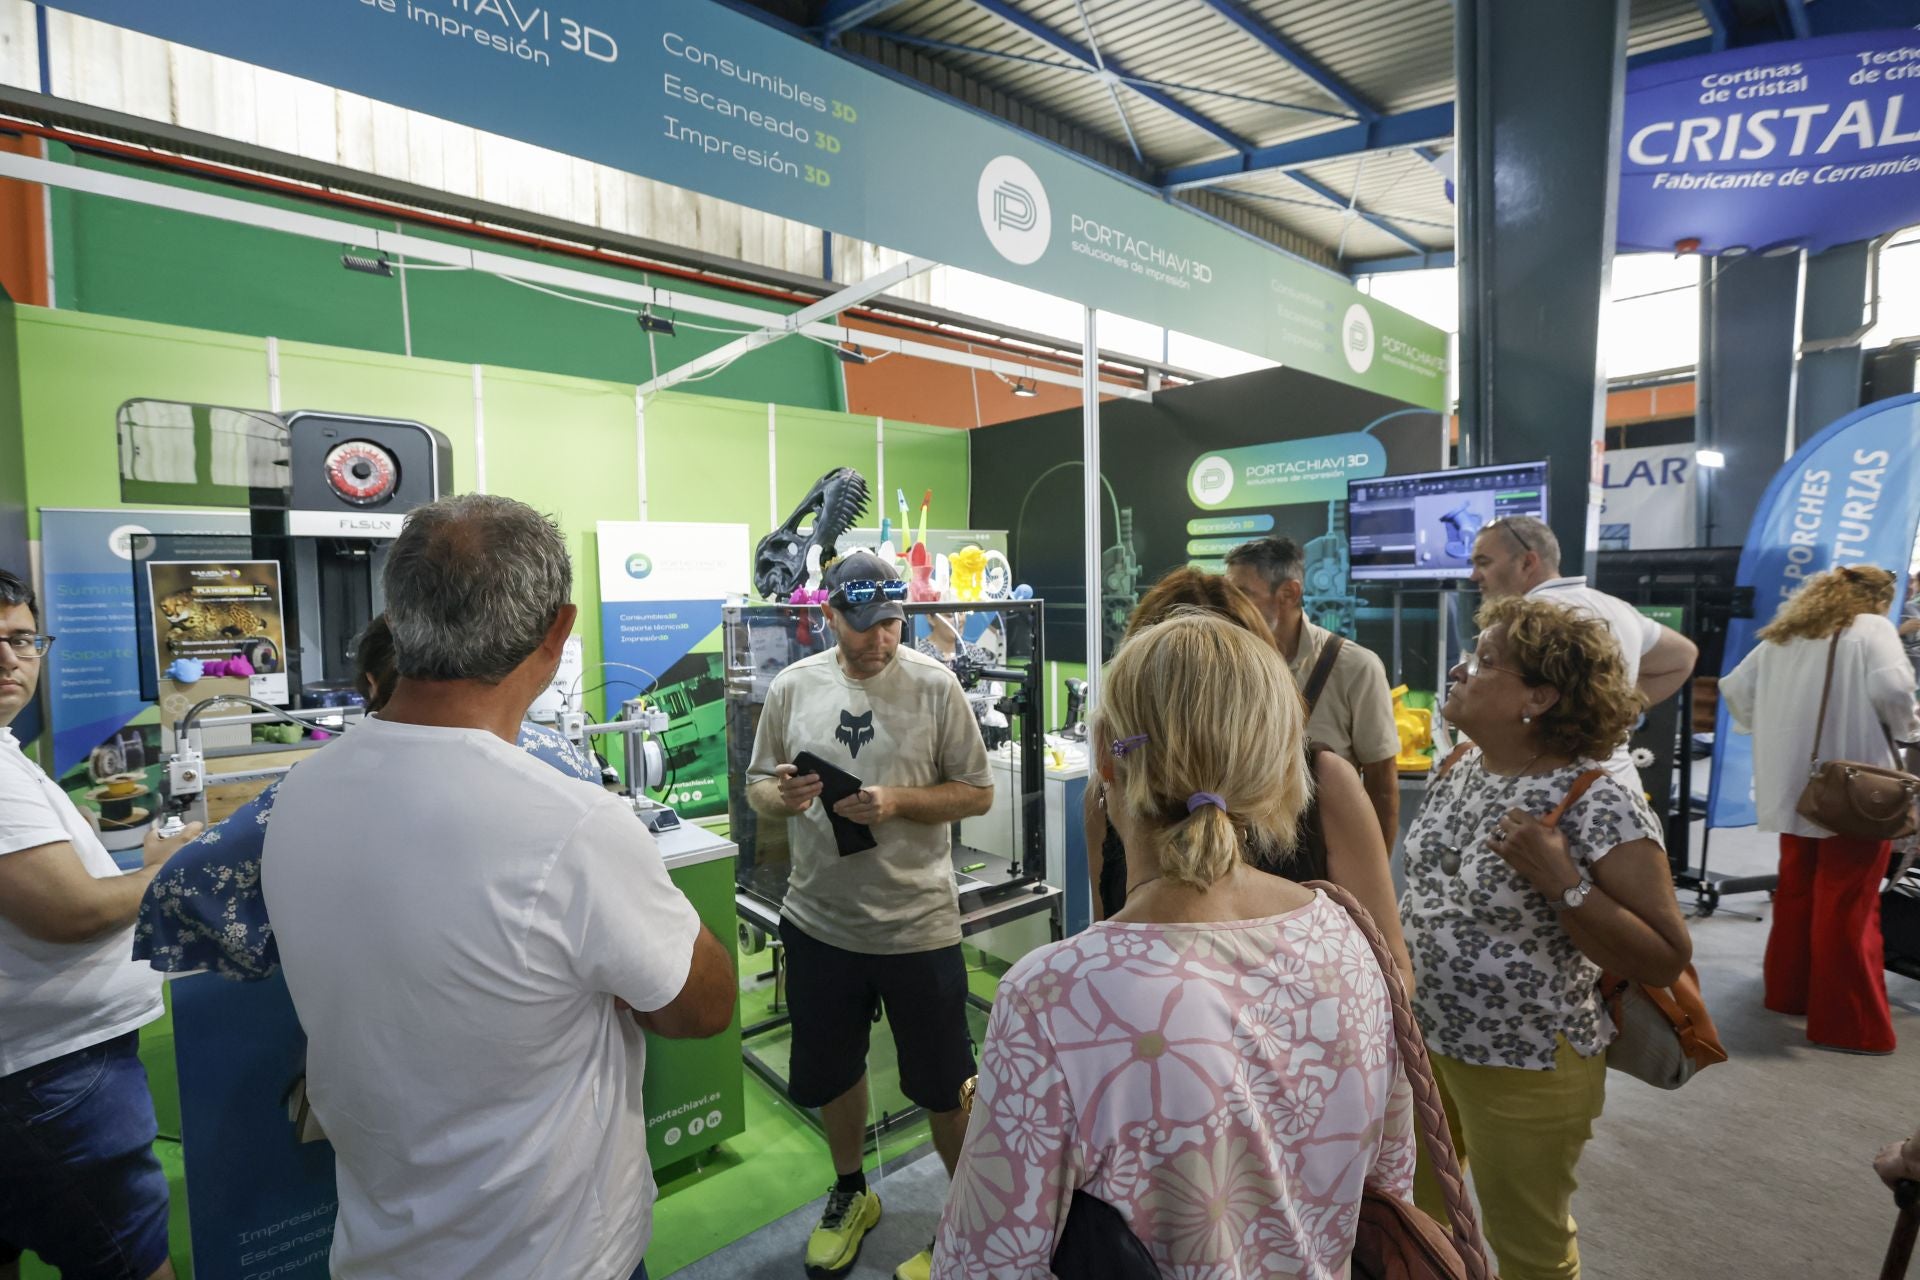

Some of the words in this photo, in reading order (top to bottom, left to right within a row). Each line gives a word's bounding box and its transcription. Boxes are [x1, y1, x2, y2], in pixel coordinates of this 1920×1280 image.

[406, 1, 550, 67] impresión
[560, 18, 618, 63] 3D
[662, 32, 828, 113] Consumibles
[831, 99, 858, 124] 3D
[1699, 89, 1730, 105] de
[1735, 75, 1809, 101] cristal
[1849, 67, 1881, 86] de
[1700, 62, 1804, 89] Cortinas
[663, 73, 809, 143] Escaneado
[815, 130, 841, 153] 3D
[1627, 94, 1920, 166] CRISTAL
[663, 115, 799, 178] Impresión
[804, 164, 831, 187] 3D
[1652, 171, 1776, 190] Fabricante
[1777, 167, 1810, 187] de
[1071, 213, 1190, 275] PORTACHIAVI
[1191, 261, 1213, 284] 3D
[1071, 240, 1129, 269] soluciones
[1130, 261, 1144, 274] de
[1145, 267, 1191, 291] impresión
[1245, 456, 1345, 478] PORTACHIAVI
[1347, 453, 1369, 468] 3D
[1783, 468, 1832, 580] PORCHES
